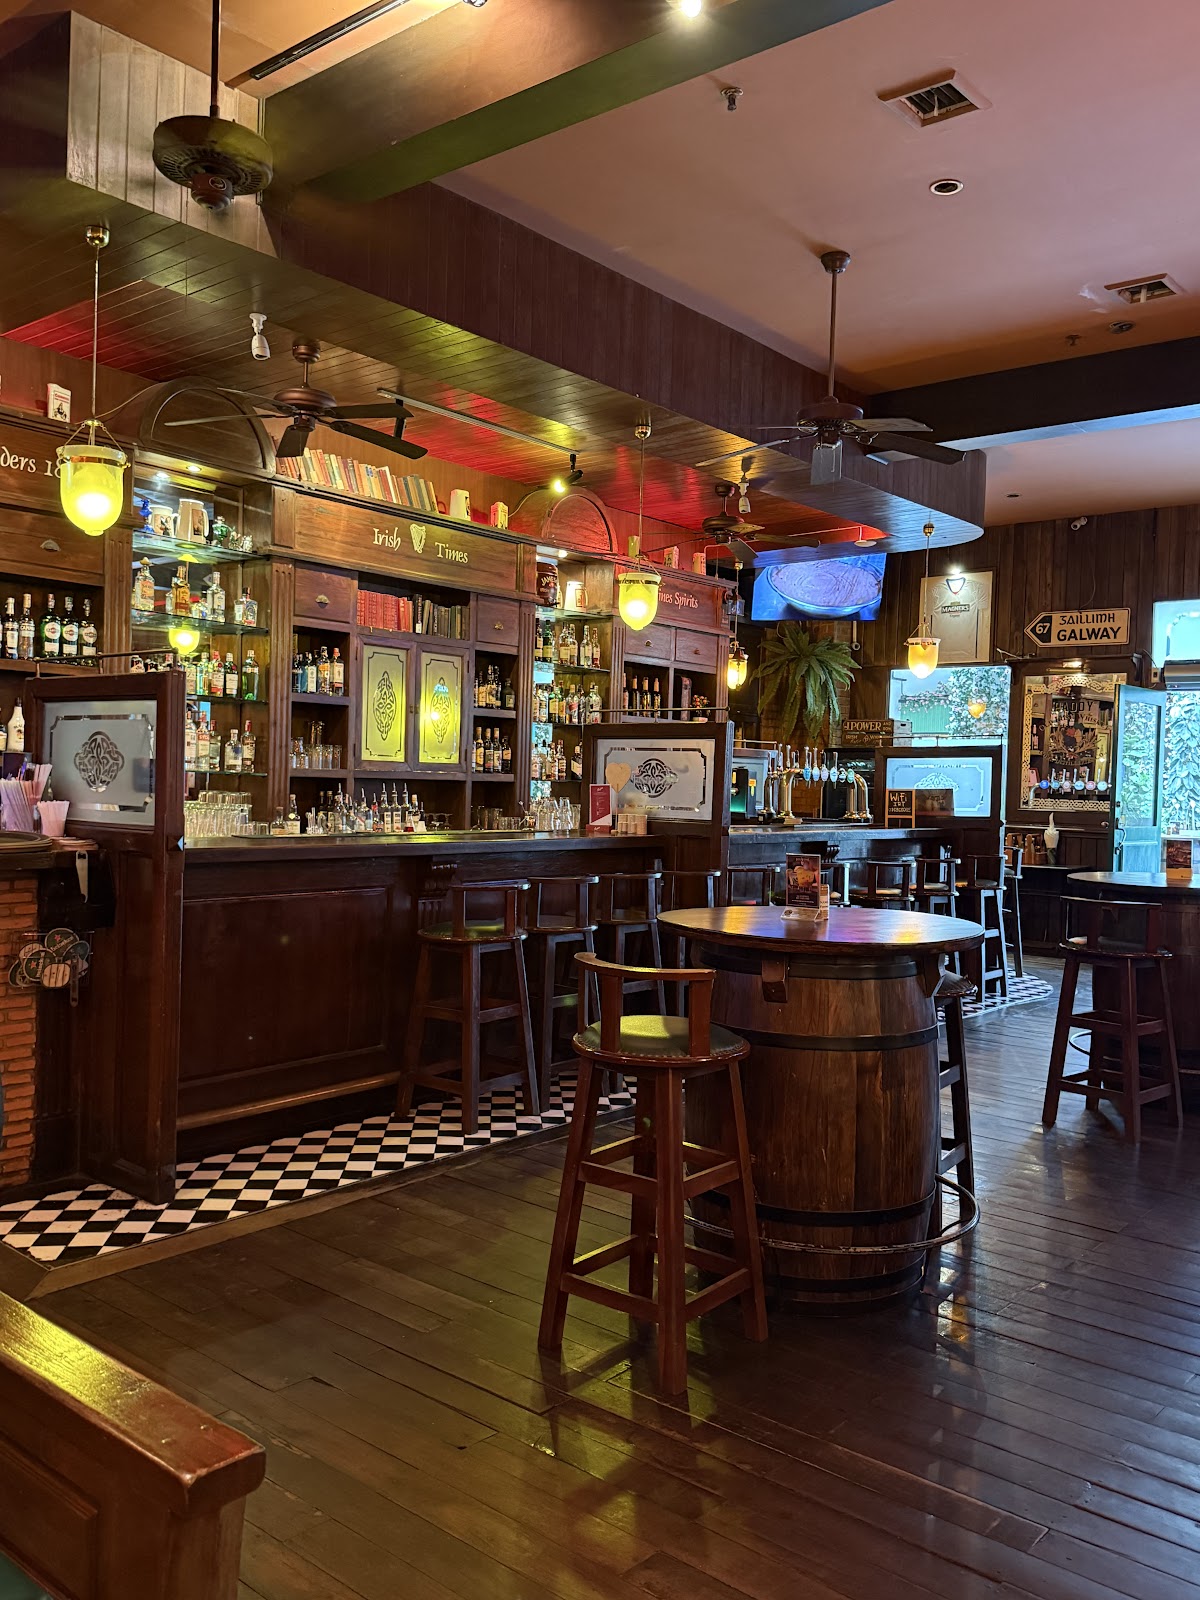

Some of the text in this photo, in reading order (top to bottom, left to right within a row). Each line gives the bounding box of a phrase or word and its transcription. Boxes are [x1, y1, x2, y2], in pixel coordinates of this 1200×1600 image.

[0, 446, 37, 473] ders
[373, 527, 469, 564] Irish Times
[674, 592, 699, 610] Spirits
[1035, 623, 1050, 635] 67
[1057, 627, 1121, 641] GALWAY
